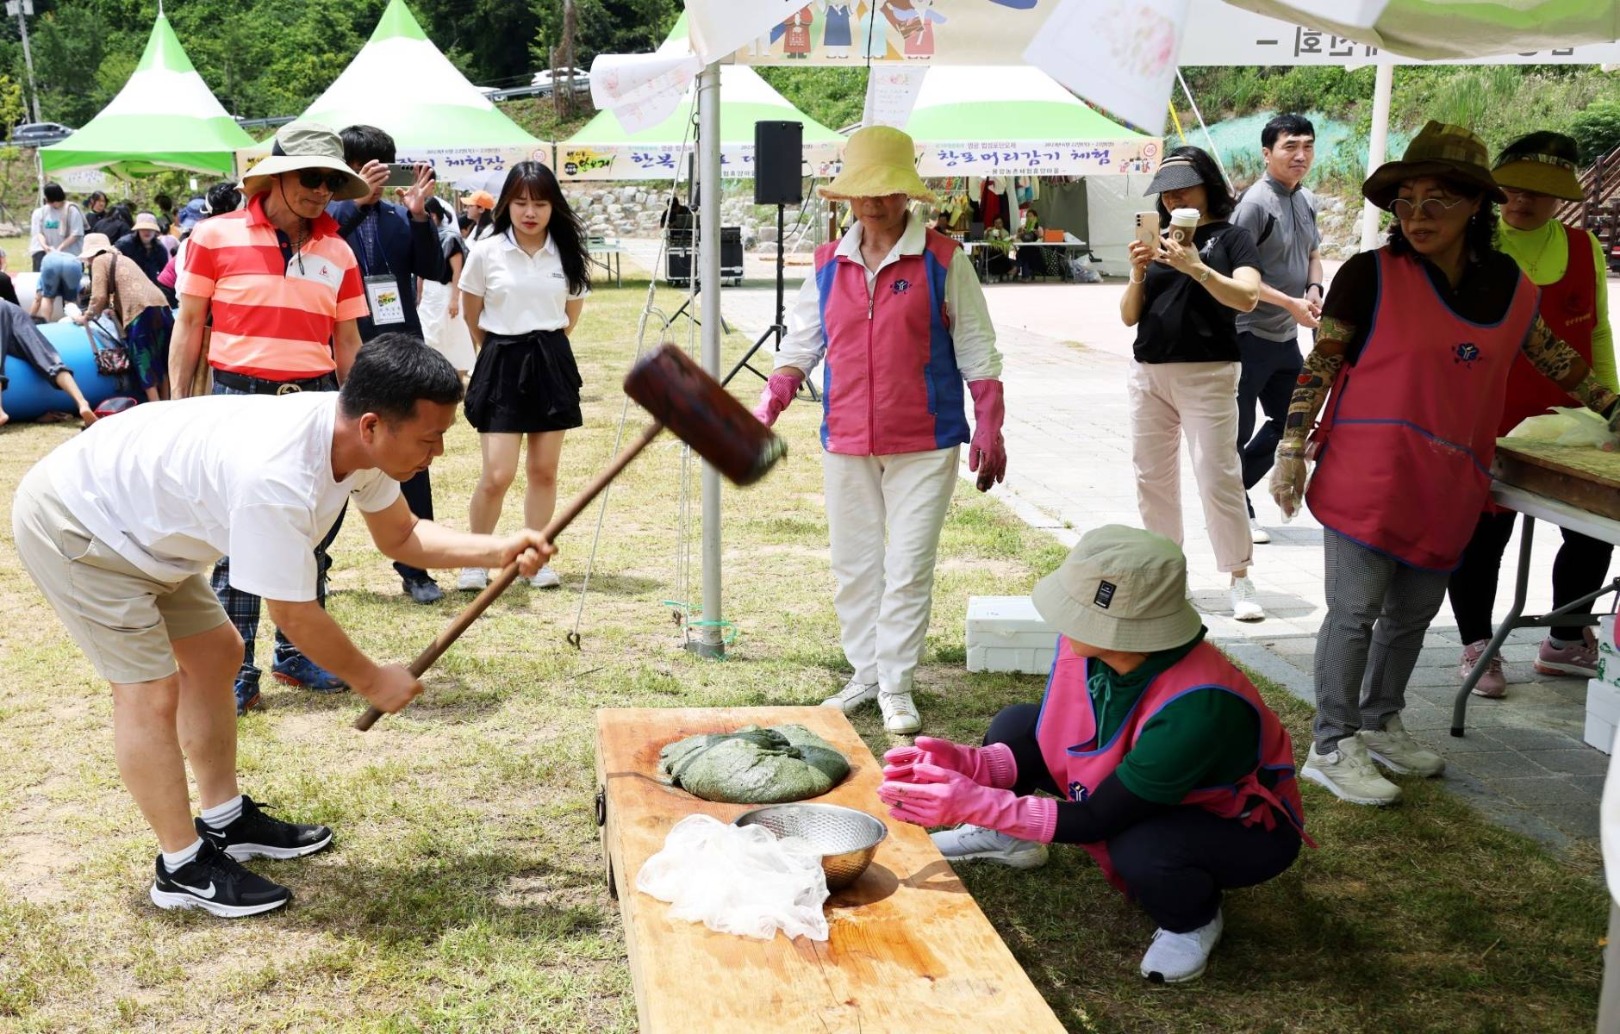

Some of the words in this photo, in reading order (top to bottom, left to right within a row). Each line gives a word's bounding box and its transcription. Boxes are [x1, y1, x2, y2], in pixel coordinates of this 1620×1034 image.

[445, 155, 505, 172] 체험장
[631, 150, 676, 169] 한복
[1071, 148, 1110, 165] 체험
